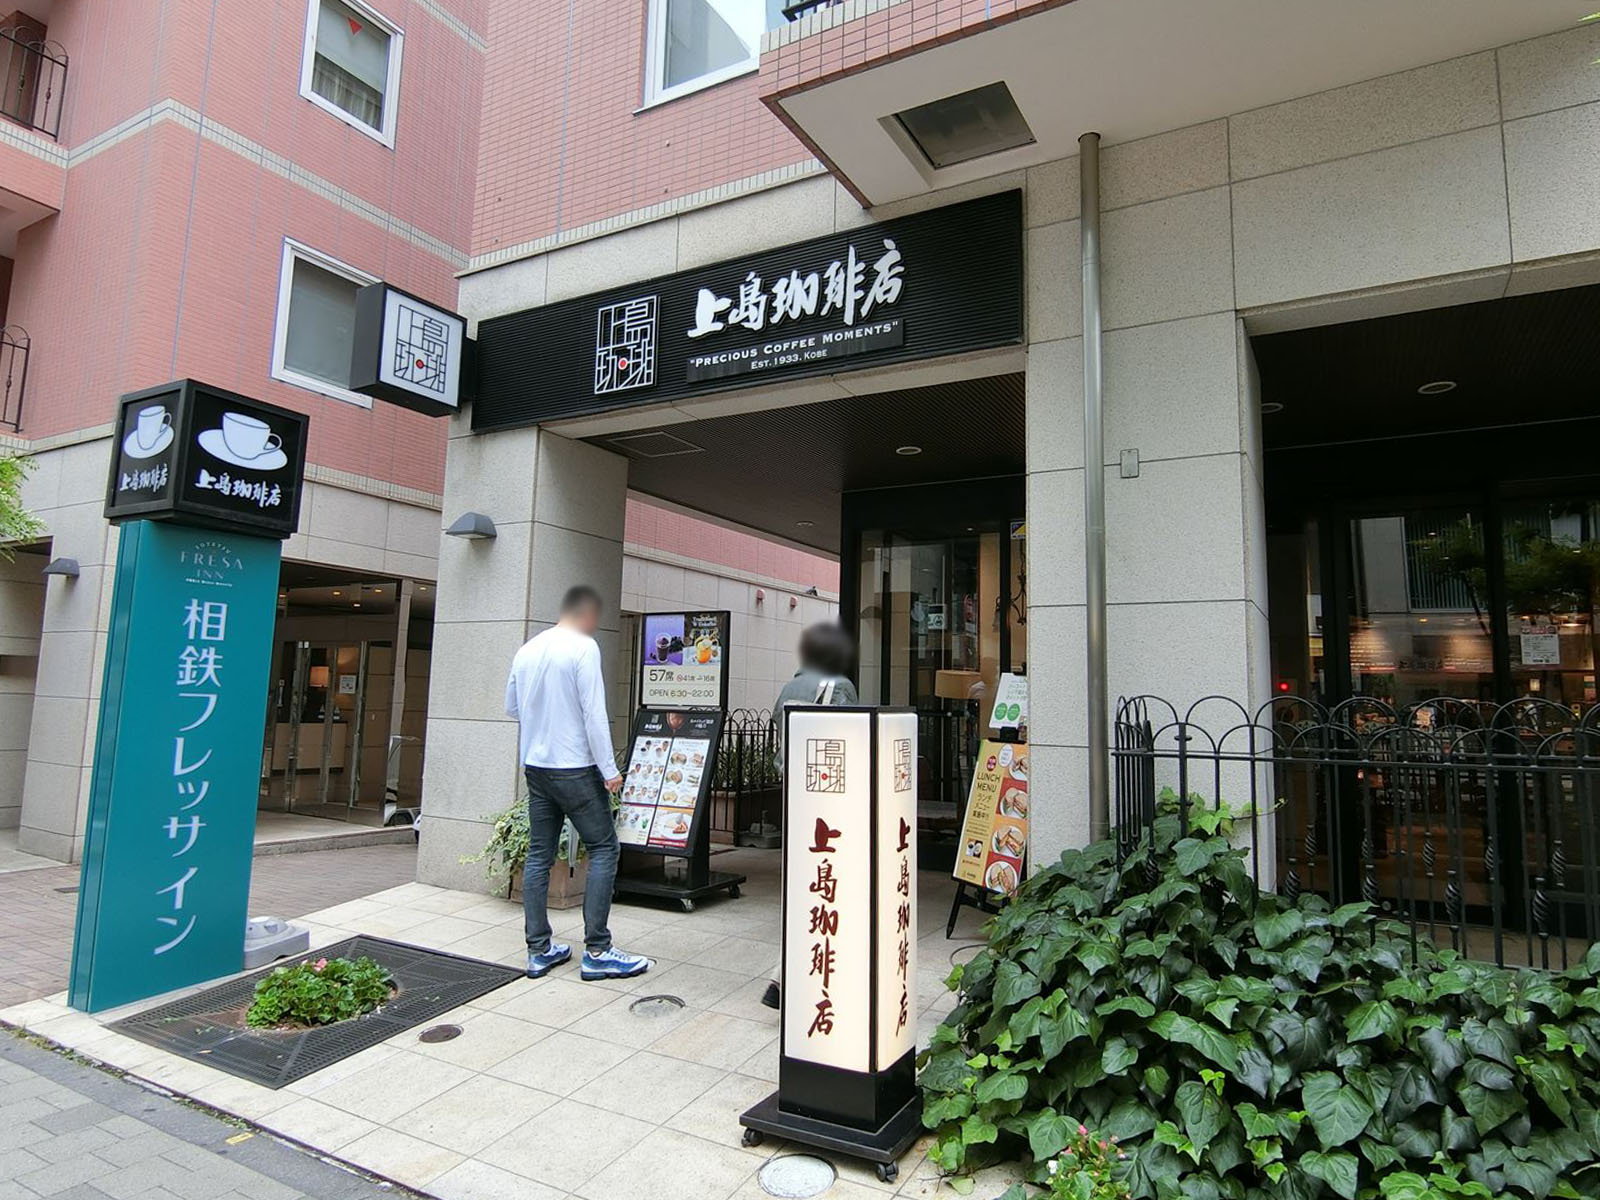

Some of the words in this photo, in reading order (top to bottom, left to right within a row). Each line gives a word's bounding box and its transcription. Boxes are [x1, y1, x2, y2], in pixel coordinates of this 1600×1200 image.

[687, 239, 905, 338] 上島珈琲店
[763, 337, 816, 354] COFFEE
[119, 463, 169, 493] 上島珈琲店
[195, 468, 282, 508] 上島珈琲店
[180, 550, 244, 570] FRESA
[197, 568, 224, 580] INN
[649, 688, 669, 697] OPEN
[153, 598, 229, 955] 相鉄フレッサイン
[976, 771, 1000, 782] LUNCH
[976, 782, 997, 793] MENU
[808, 817, 841, 1037] 上島珈琲店
[896, 817, 911, 1037] 上島珈琲店
